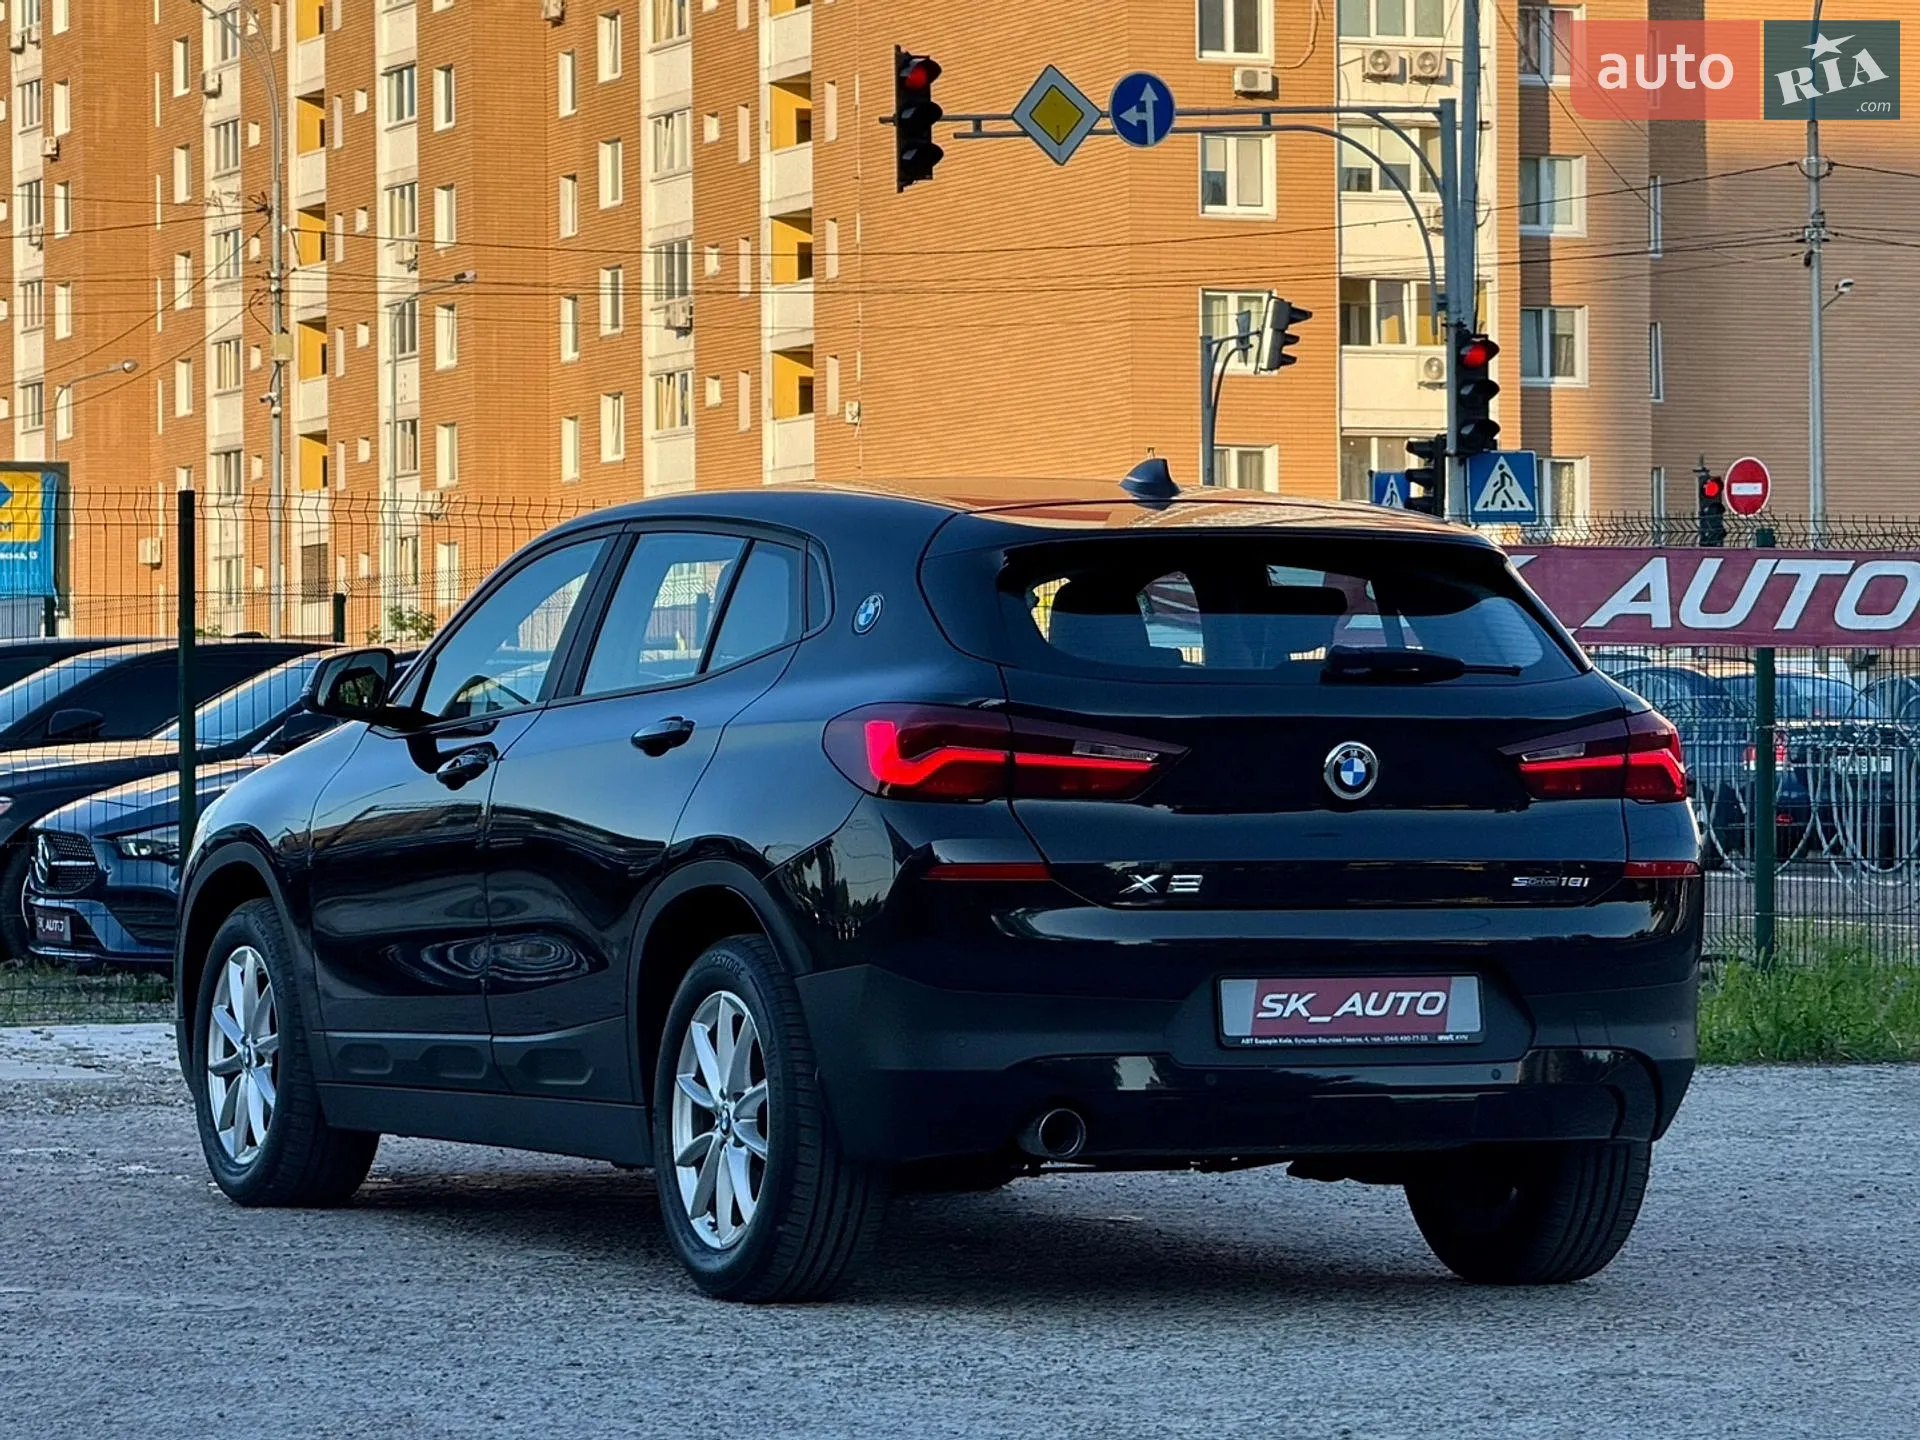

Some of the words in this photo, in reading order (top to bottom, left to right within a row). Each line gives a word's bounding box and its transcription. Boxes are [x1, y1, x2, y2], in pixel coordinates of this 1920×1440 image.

[1505, 554, 1920, 635] AUTO
[1119, 874, 1204, 894] X2
[1256, 991, 1447, 1023] SK_AUTO
